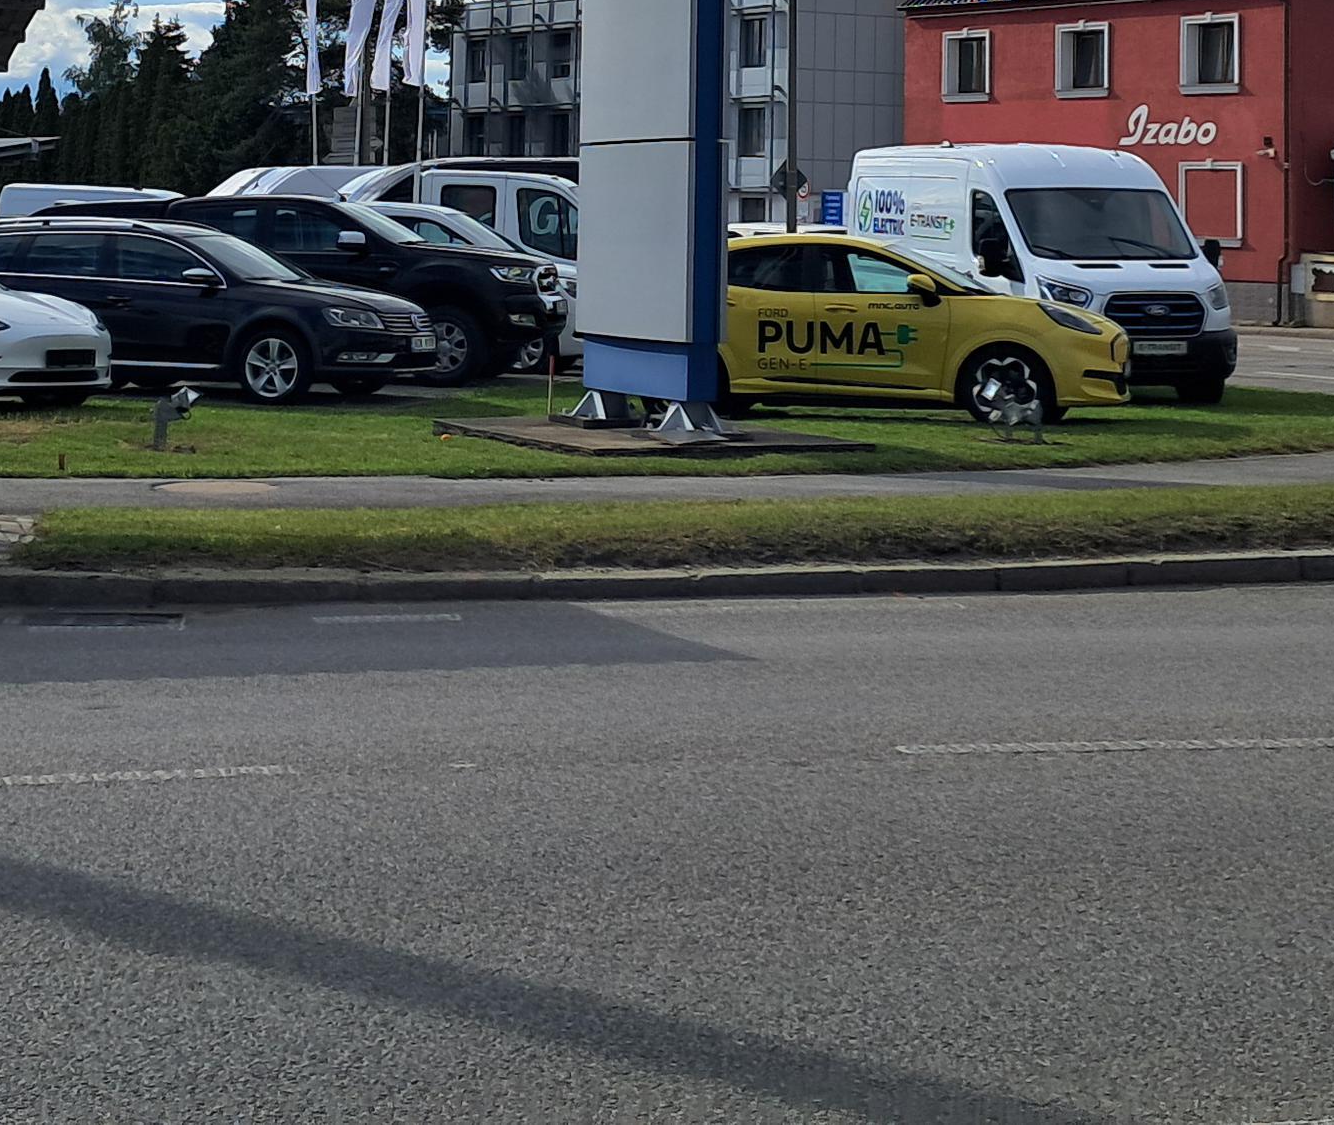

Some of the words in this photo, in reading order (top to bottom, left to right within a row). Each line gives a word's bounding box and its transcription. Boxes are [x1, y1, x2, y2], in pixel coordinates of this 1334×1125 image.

[1119, 104, 1217, 146] Izabo
[874, 189, 905, 215] 100%
[873, 218, 905, 236] ELECTRIC
[758, 308, 789, 318] FORD
[758, 320, 886, 356] PUMA
[757, 358, 808, 371] GEN-E
